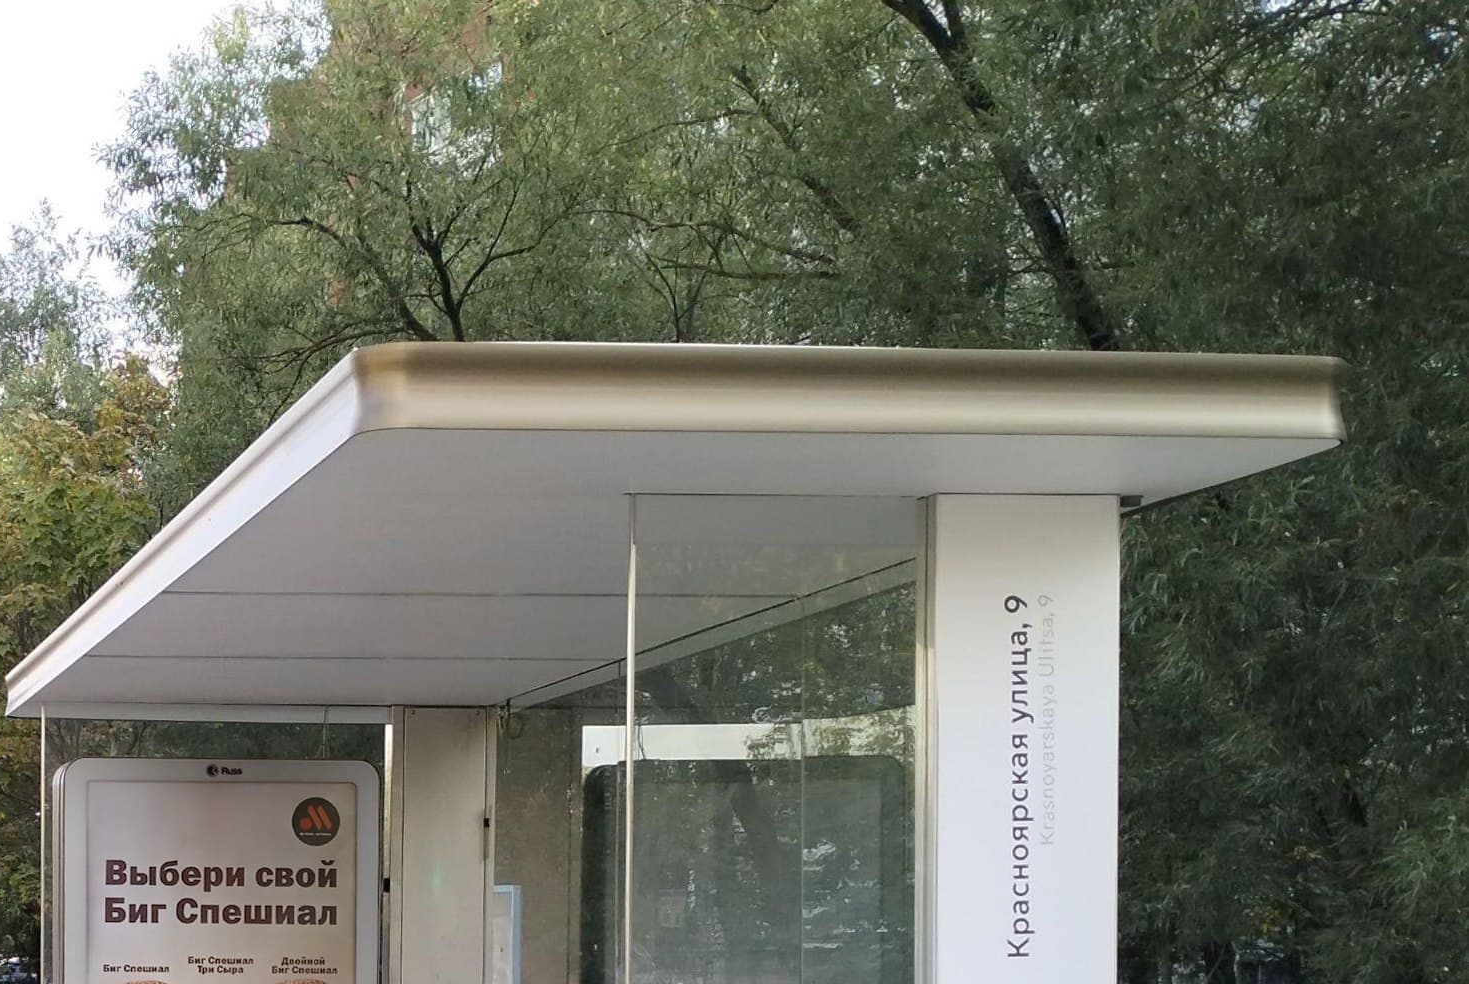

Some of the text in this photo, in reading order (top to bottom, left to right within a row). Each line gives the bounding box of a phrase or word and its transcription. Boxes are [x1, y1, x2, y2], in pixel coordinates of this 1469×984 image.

[1037, 594, 1054, 607] 9
[1038, 682, 1058, 846] Krasnoyarskaya
[221, 767, 243, 776] Russ
[1003, 594, 1035, 957] Красноярская улица, 9
[104, 859, 338, 892] Выбери свой
[104, 897, 338, 925] Биг Спешиал
[188, 956, 254, 965] Биг Спешиал
[281, 956, 326, 966] Двойной
[103, 964, 170, 973] Биг Спешиал
[197, 965, 244, 975] Три Сыра
[271, 966, 338, 975] Биг Спешиал
